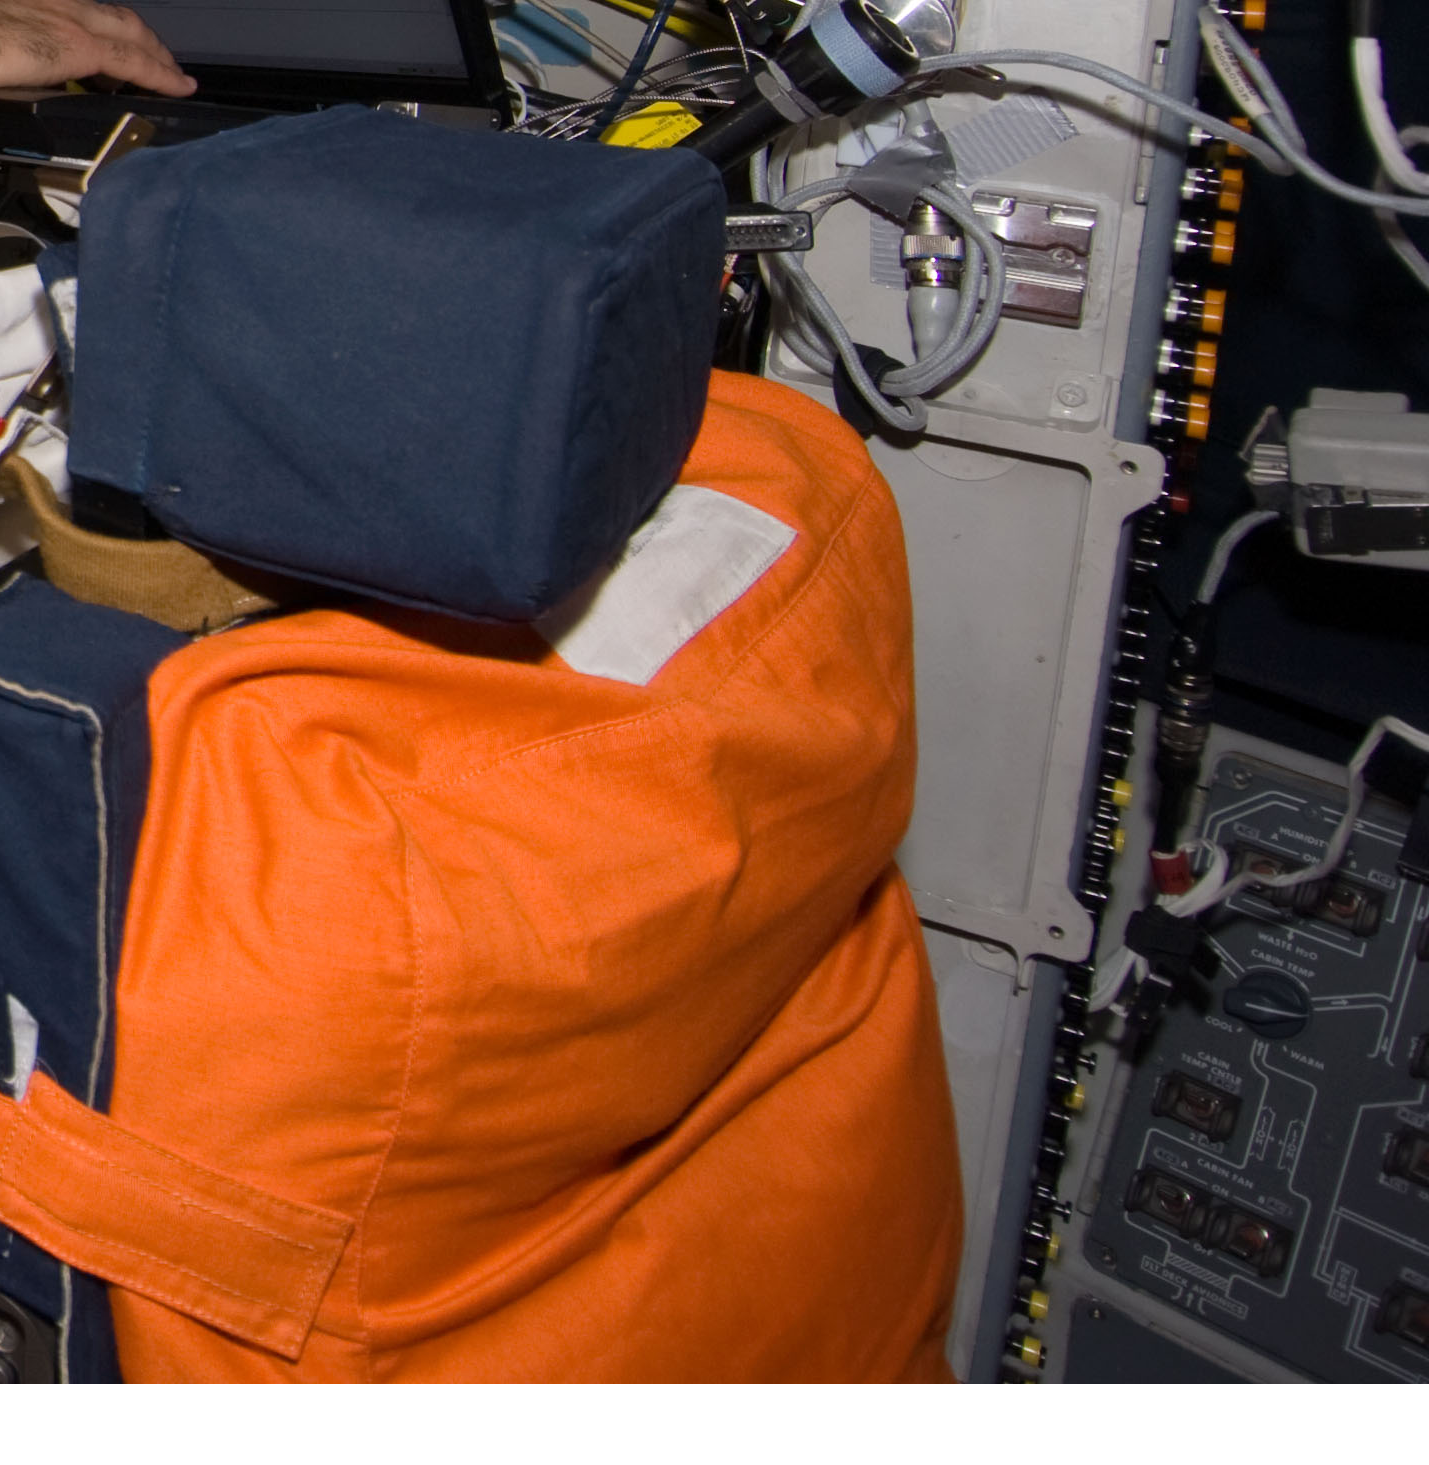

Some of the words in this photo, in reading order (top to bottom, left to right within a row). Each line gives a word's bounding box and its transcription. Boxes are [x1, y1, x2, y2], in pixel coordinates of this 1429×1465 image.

[1257, 931, 1291, 952] WASTE
[1251, 947, 1284, 969] CABIN
[1286, 961, 1316, 979] TEMP
[1204, 1014, 1233, 1032] COOL
[1289, 1048, 1325, 1071] WARM
[1196, 1157, 1230, 1180] CABIN
[1232, 1171, 1253, 1189] FAN
[1142, 1256, 1159, 1272] FLT
[1161, 1264, 1189, 1289] DECK
[1192, 1280, 1246, 1318] AVIONICS
